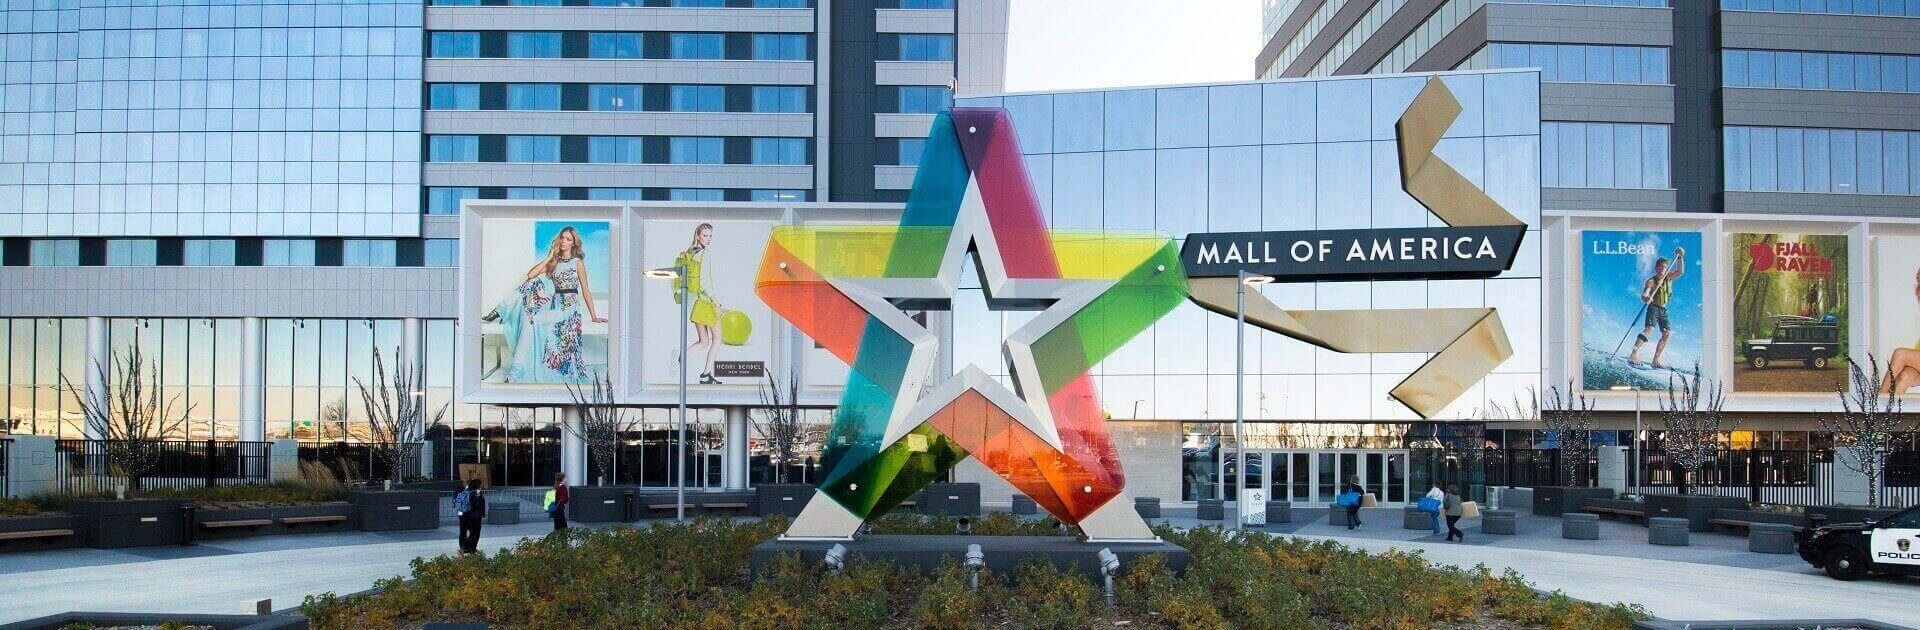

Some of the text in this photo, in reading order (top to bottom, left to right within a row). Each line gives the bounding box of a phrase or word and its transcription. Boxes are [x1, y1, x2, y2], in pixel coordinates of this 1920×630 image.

[1197, 235, 1497, 265] MALL OF AMERICA
[1592, 240, 1656, 255] L.L.Bean
